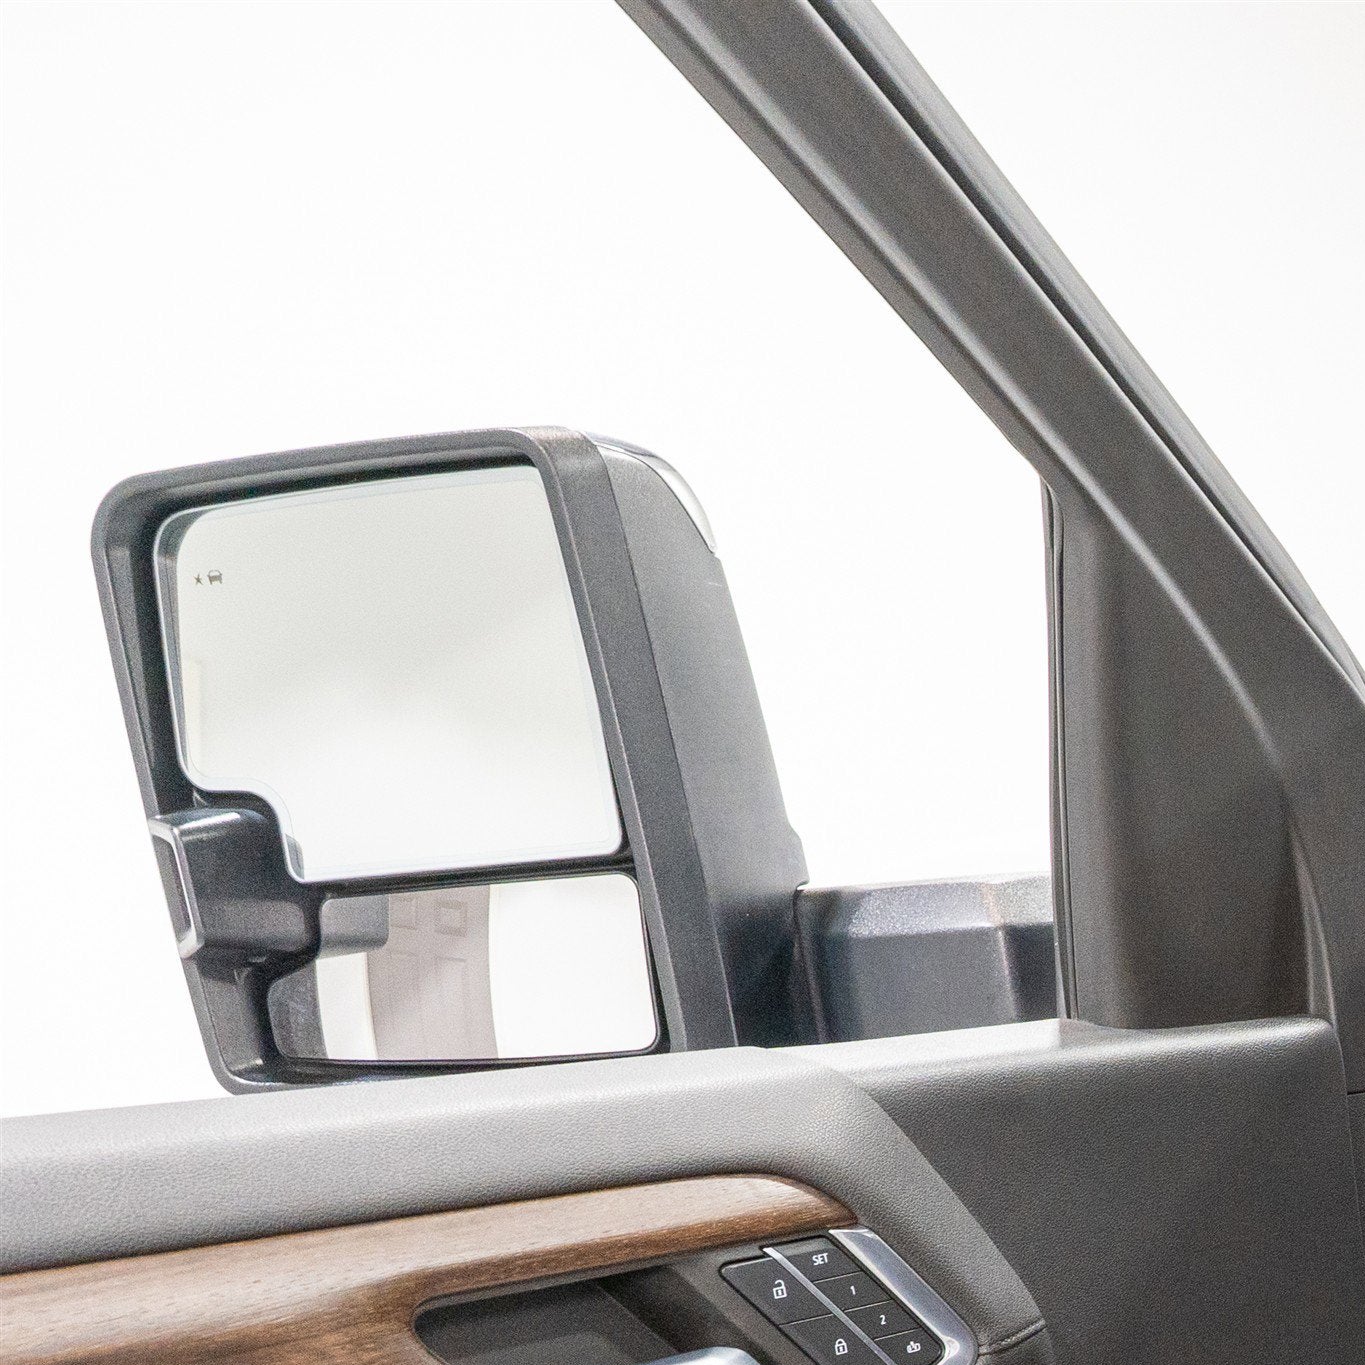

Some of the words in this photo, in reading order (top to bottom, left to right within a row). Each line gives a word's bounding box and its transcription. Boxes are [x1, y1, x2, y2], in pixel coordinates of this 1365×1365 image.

[811, 1252, 829, 1266] SET
[850, 1285, 857, 1295] 1
[879, 1314, 887, 1326] 2
